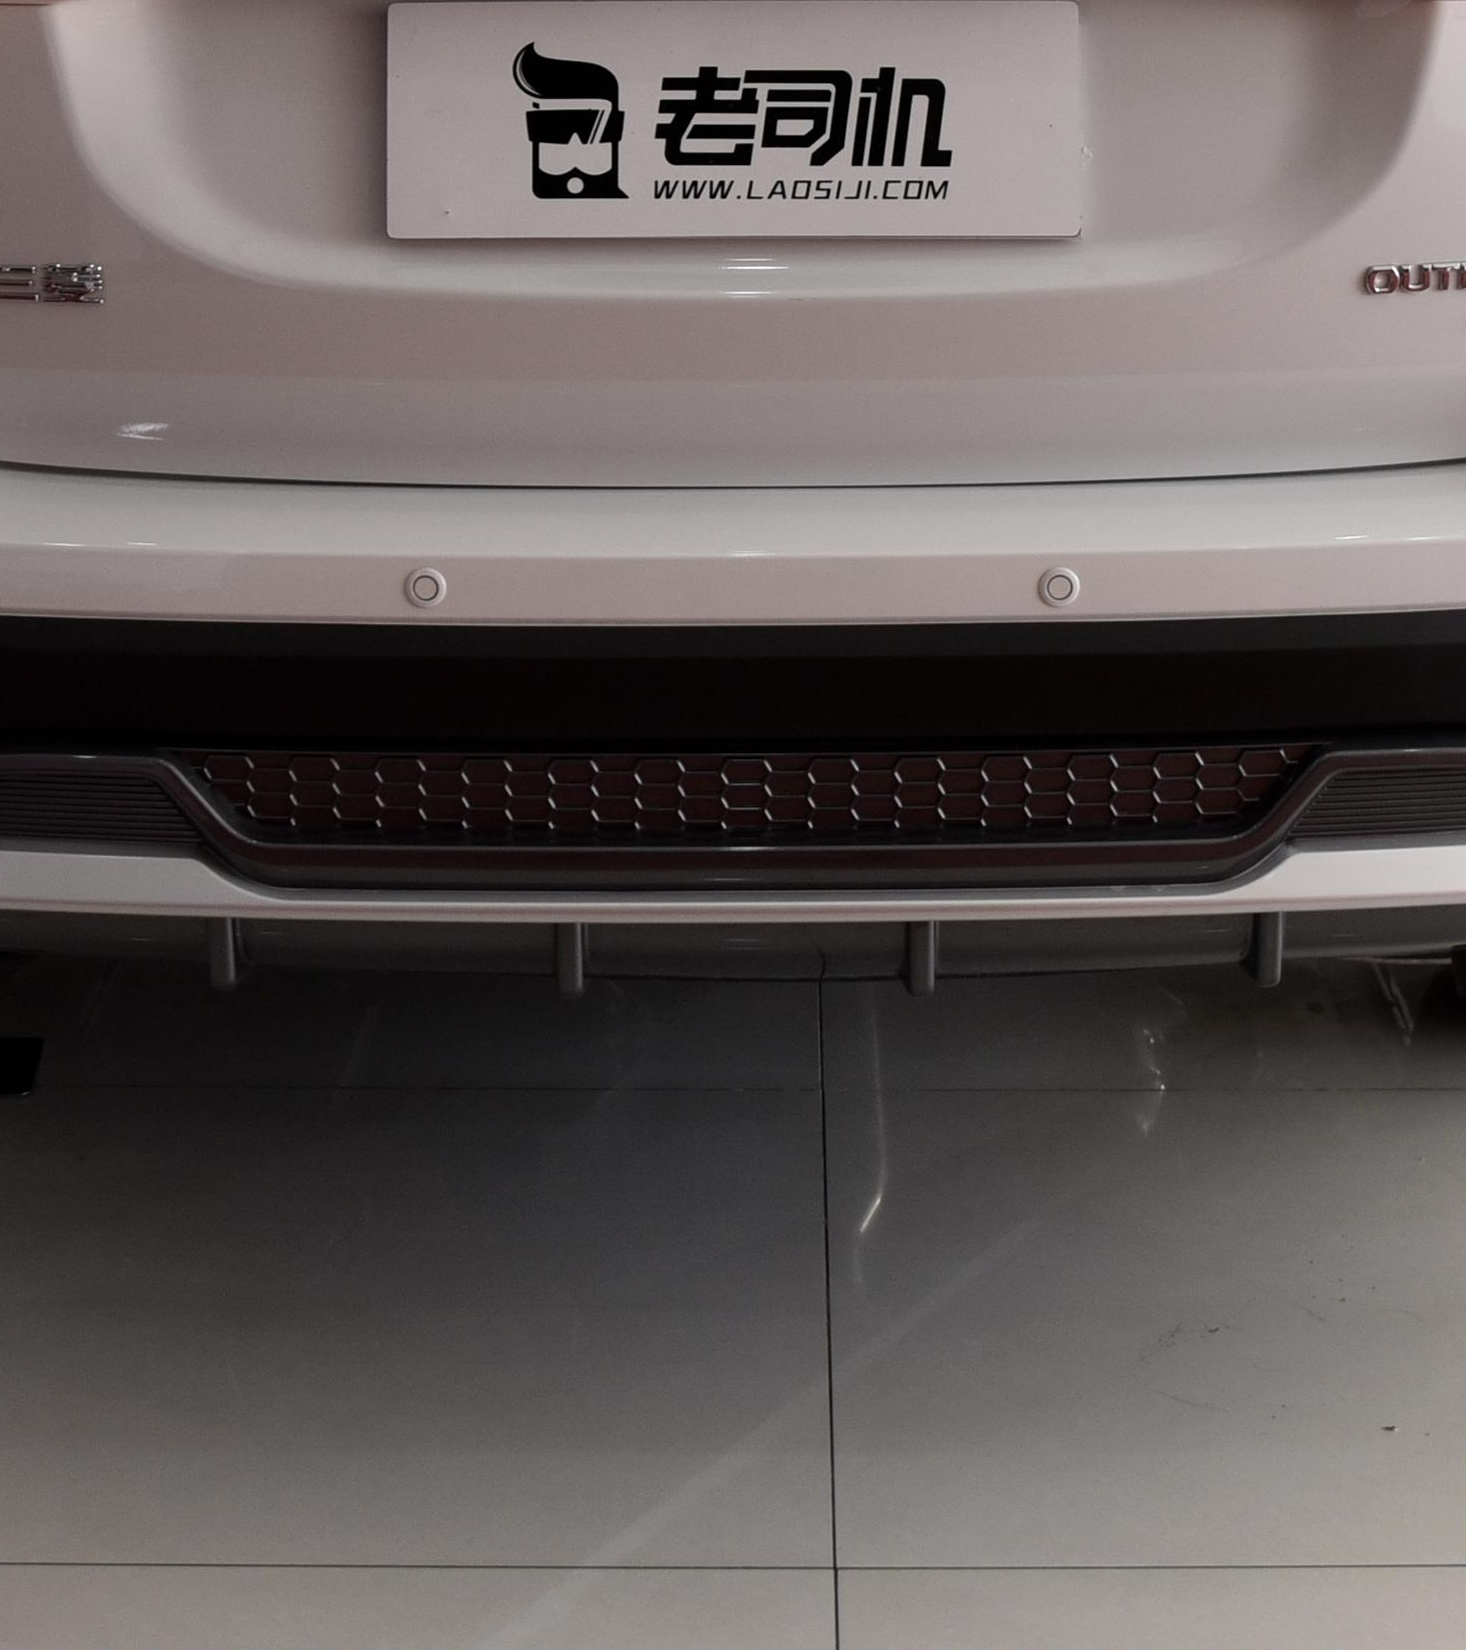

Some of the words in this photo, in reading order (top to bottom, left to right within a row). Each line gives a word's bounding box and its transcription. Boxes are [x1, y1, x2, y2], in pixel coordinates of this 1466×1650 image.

[654, 66, 954, 168] 老司机
[653, 179, 951, 201] WWW.LAOSIJI.COM
